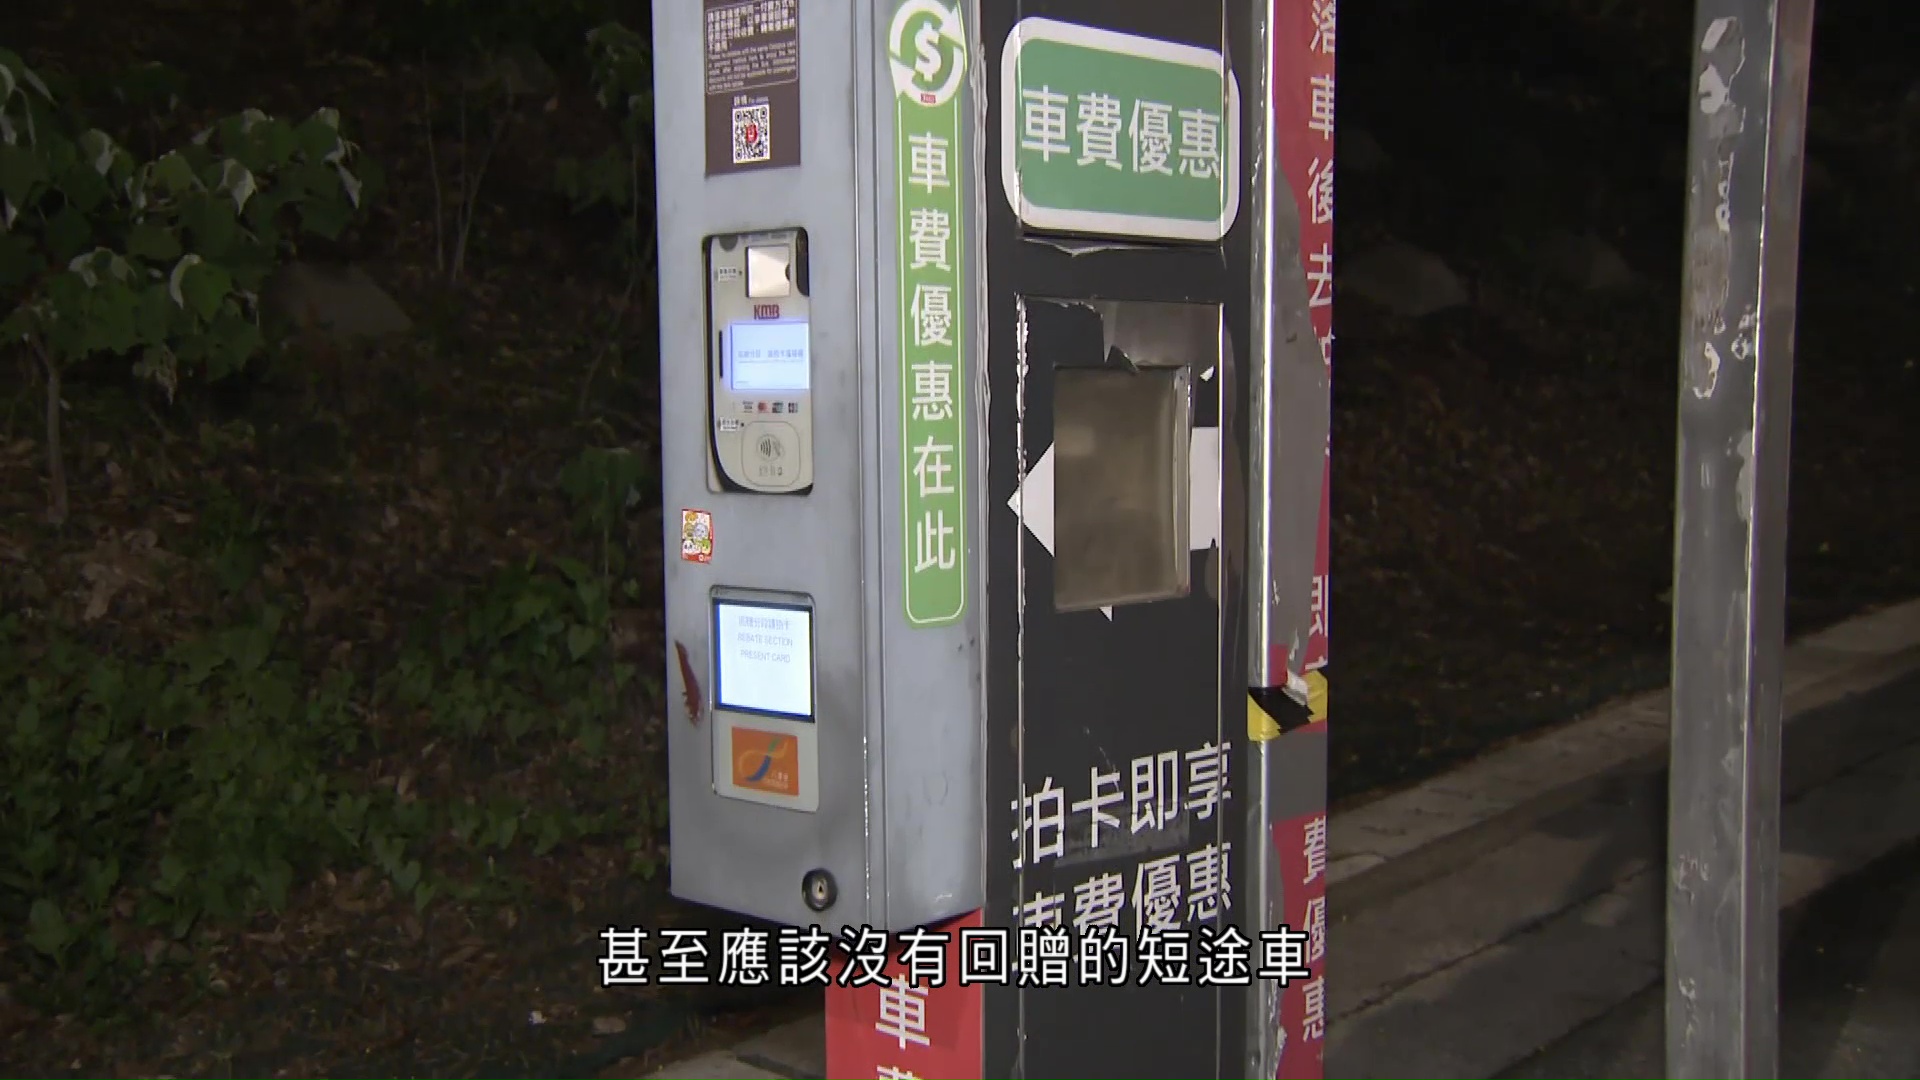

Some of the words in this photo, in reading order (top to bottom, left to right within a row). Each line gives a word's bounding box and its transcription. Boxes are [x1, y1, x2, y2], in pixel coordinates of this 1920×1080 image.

[1022, 85, 1220, 179] 車費優惠
[753, 304, 780, 320] KMB
[908, 131, 956, 574] 車費優惠在此
[740, 649, 771, 662] PRESENT
[772, 652, 791, 664] CARD
[764, 635, 793, 648] SECTION
[1011, 741, 1231, 869] 拍卡即享
